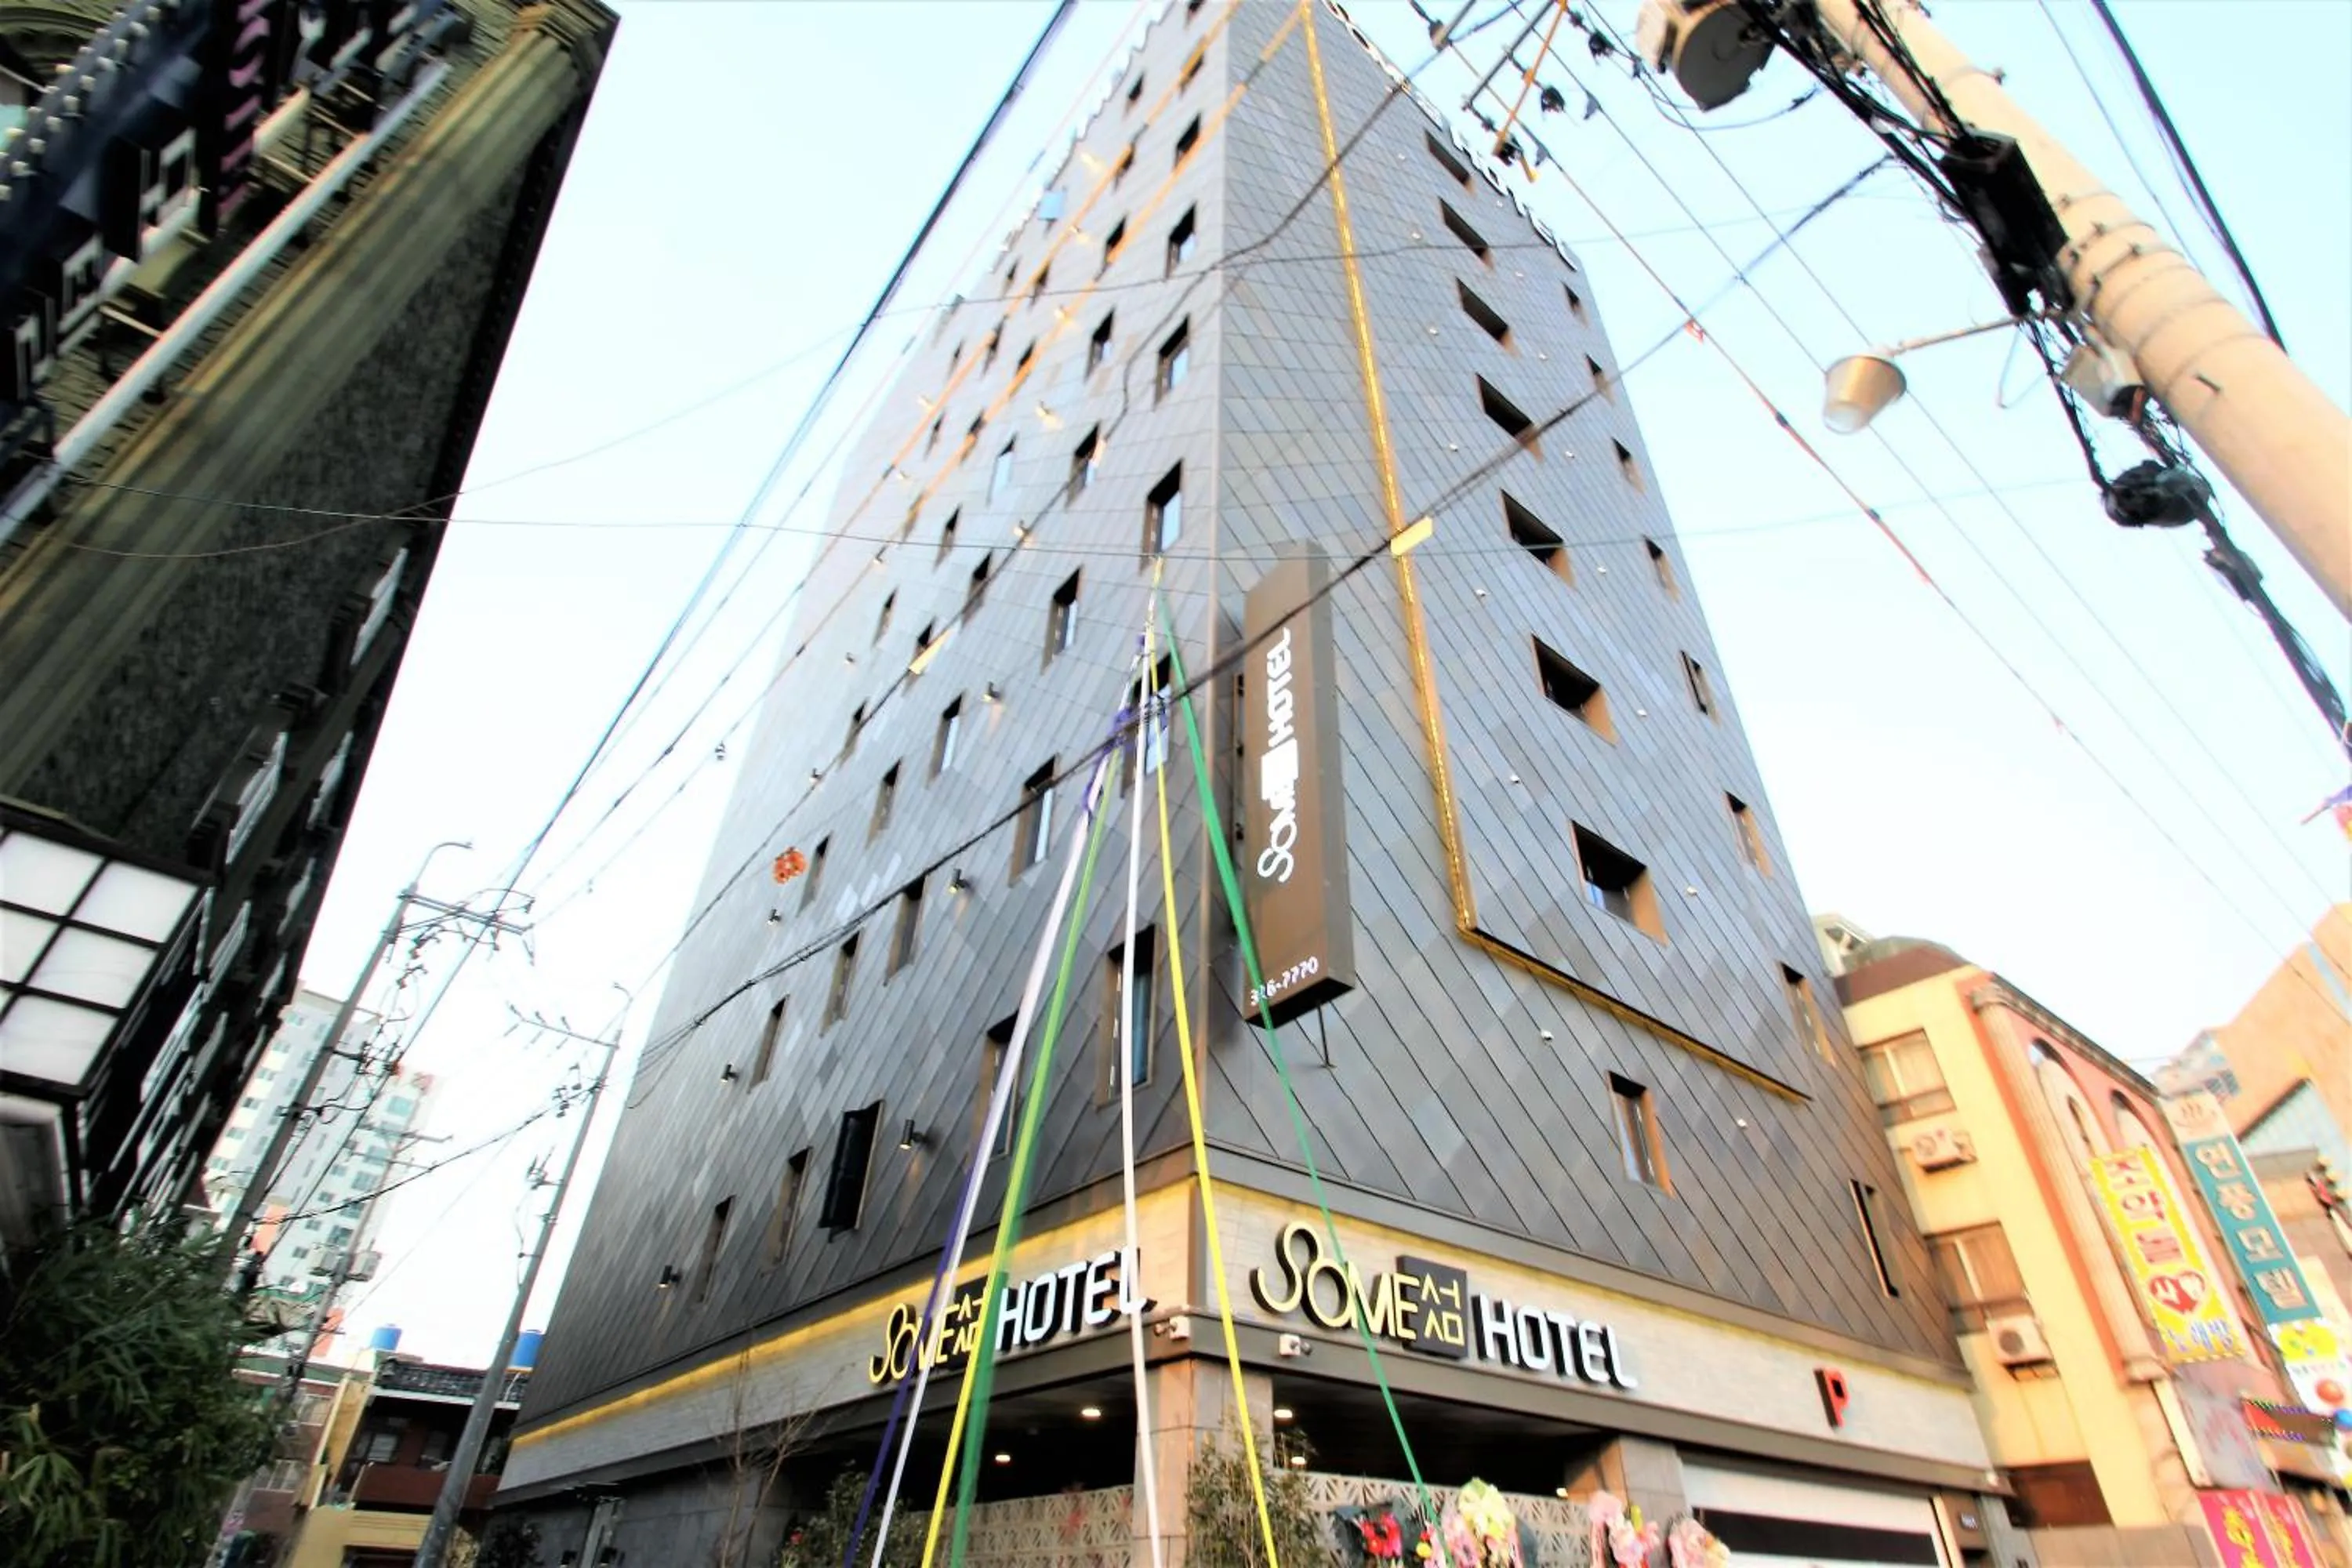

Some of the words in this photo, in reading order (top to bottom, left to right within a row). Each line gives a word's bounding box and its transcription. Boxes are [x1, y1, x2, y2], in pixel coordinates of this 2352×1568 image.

[1266, 626, 1294, 747] HOTEL
[996, 1245, 1151, 1351] HOTEL
[1250, 1221, 1417, 1340] SOME
[1474, 1293, 1638, 1389] HOTEL
